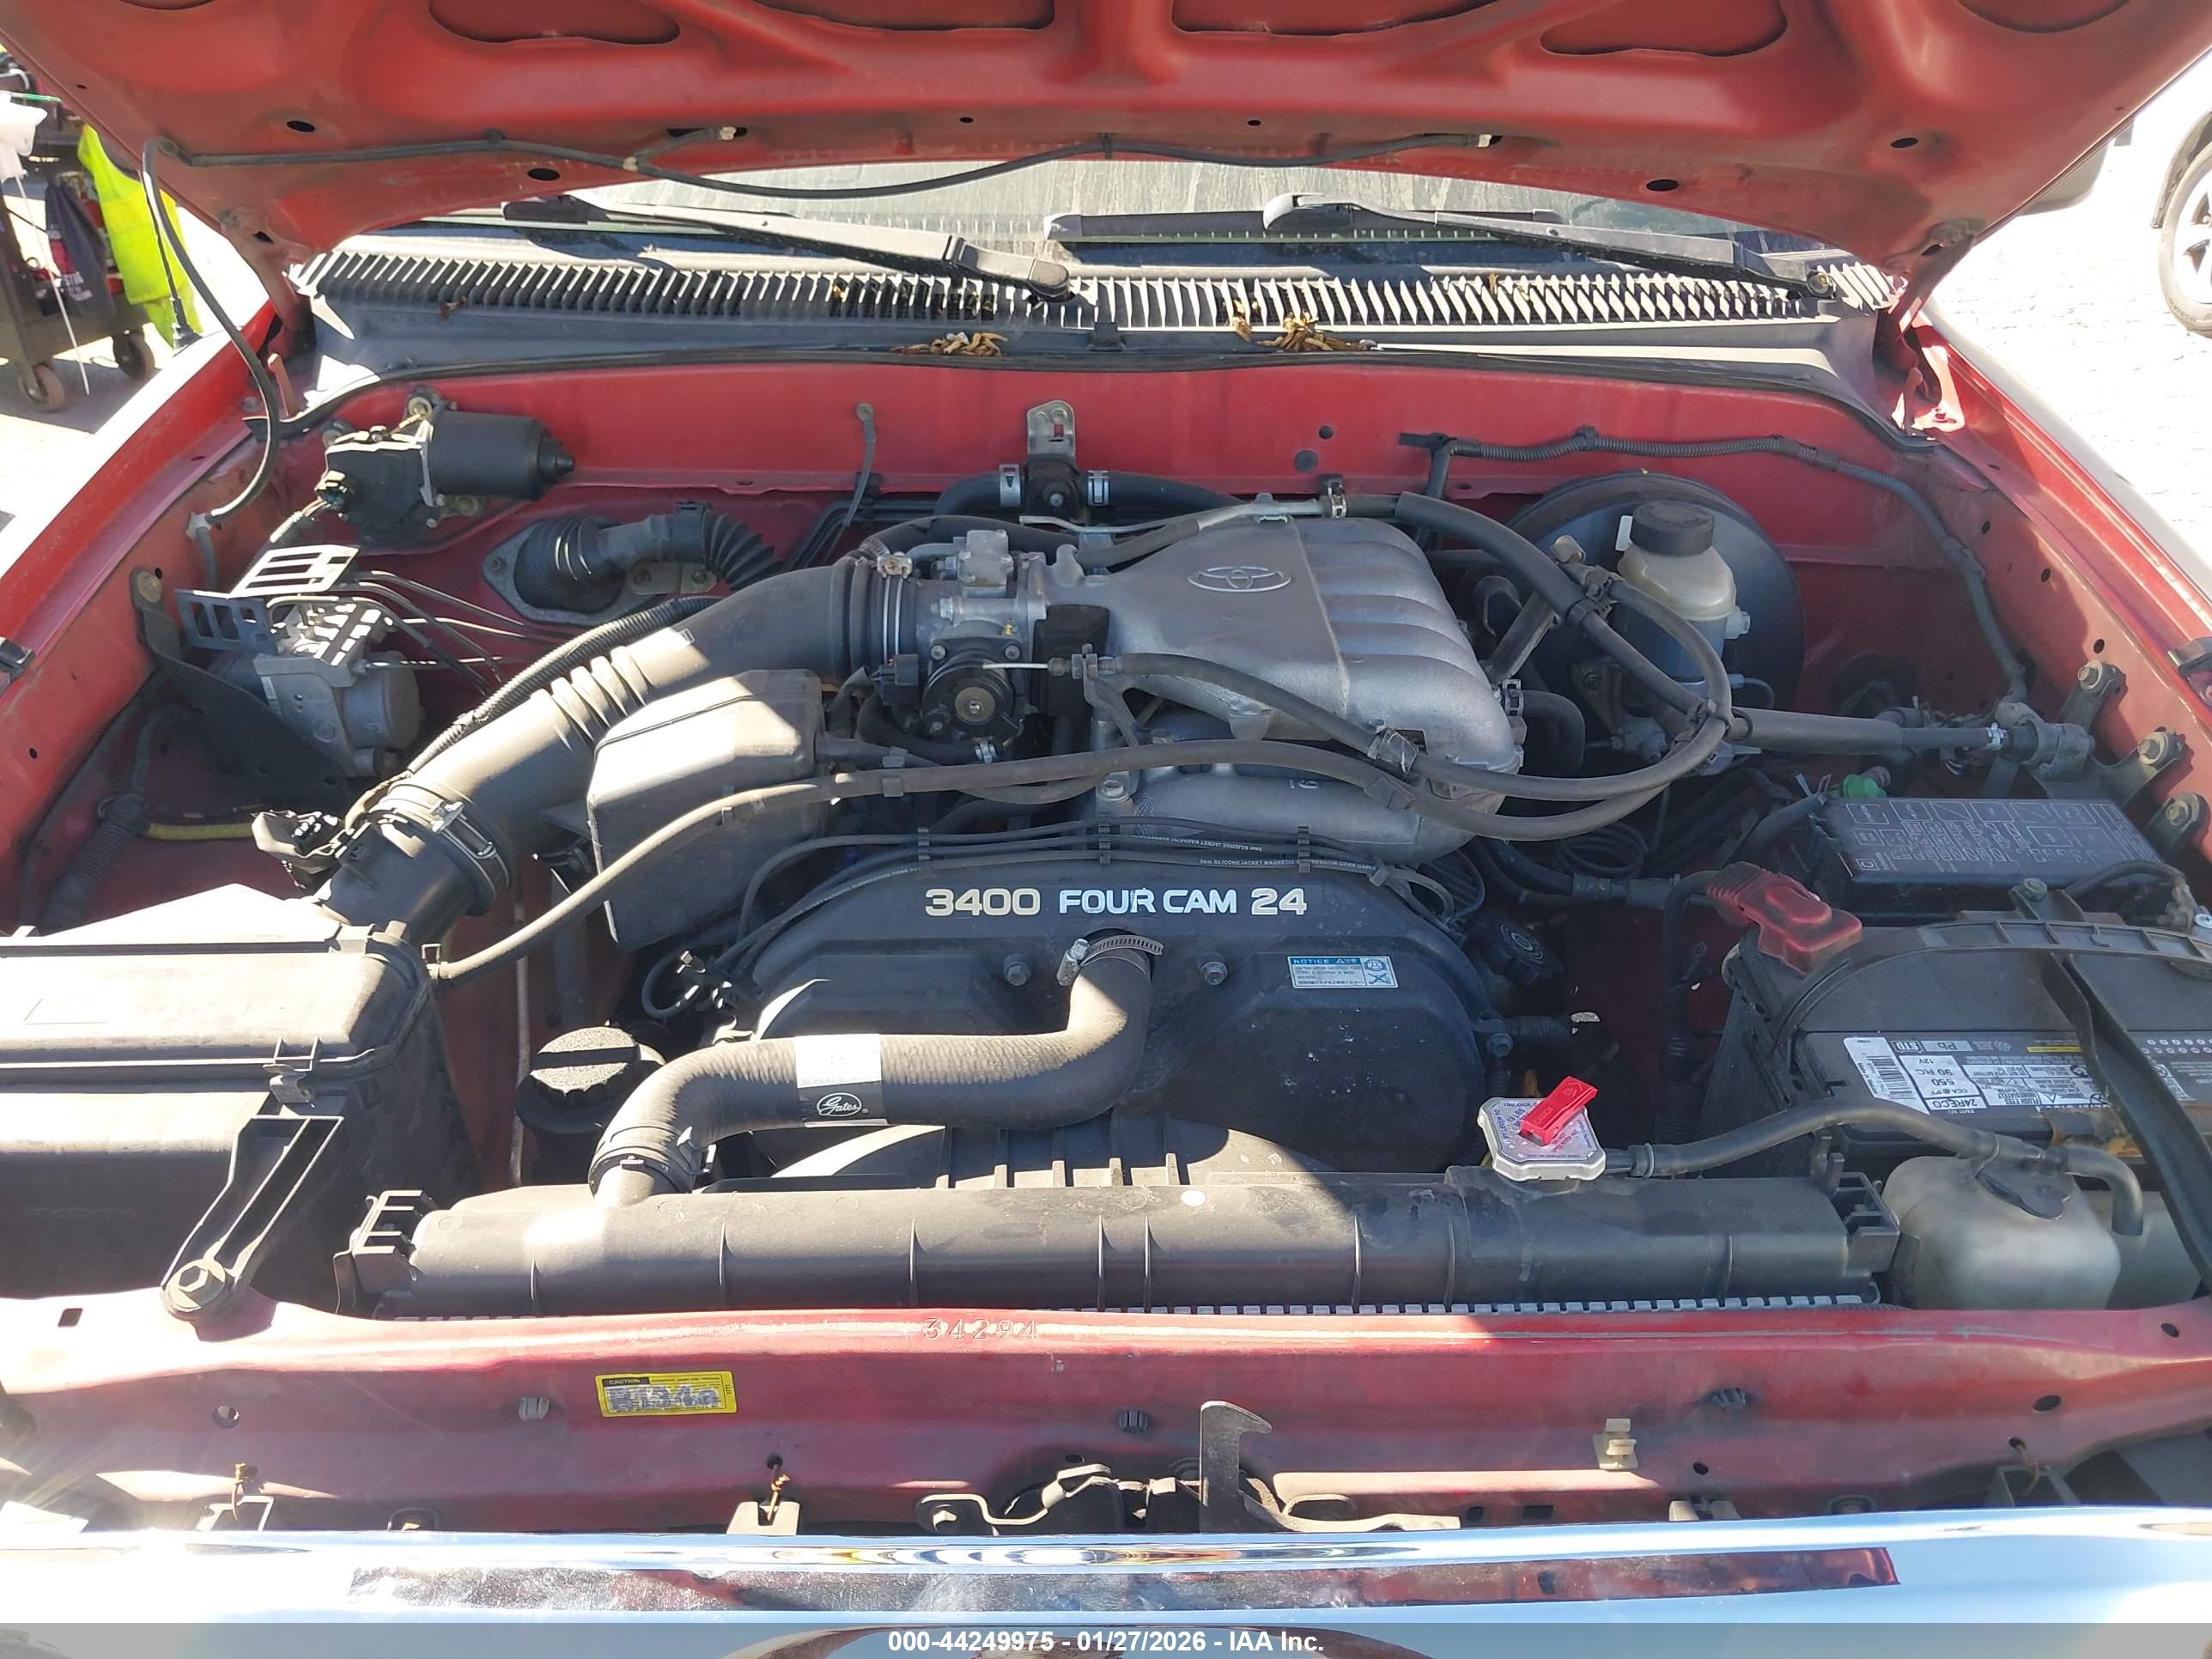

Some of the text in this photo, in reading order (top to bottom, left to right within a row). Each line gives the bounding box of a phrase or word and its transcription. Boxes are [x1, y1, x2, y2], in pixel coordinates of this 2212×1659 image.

[926, 888, 1041, 916] 3400
[1059, 888, 1157, 914] FOUR
[1163, 889, 1237, 914] CAM
[1250, 888, 1307, 915] 24
[1895, 1042, 1919, 1050] STD
[1936, 1042, 1958, 1050] Pb
[819, 1096, 859, 1116] Gates
[1932, 1098, 1978, 1108] 24RECO
[924, 1317, 1037, 1340] 34294
